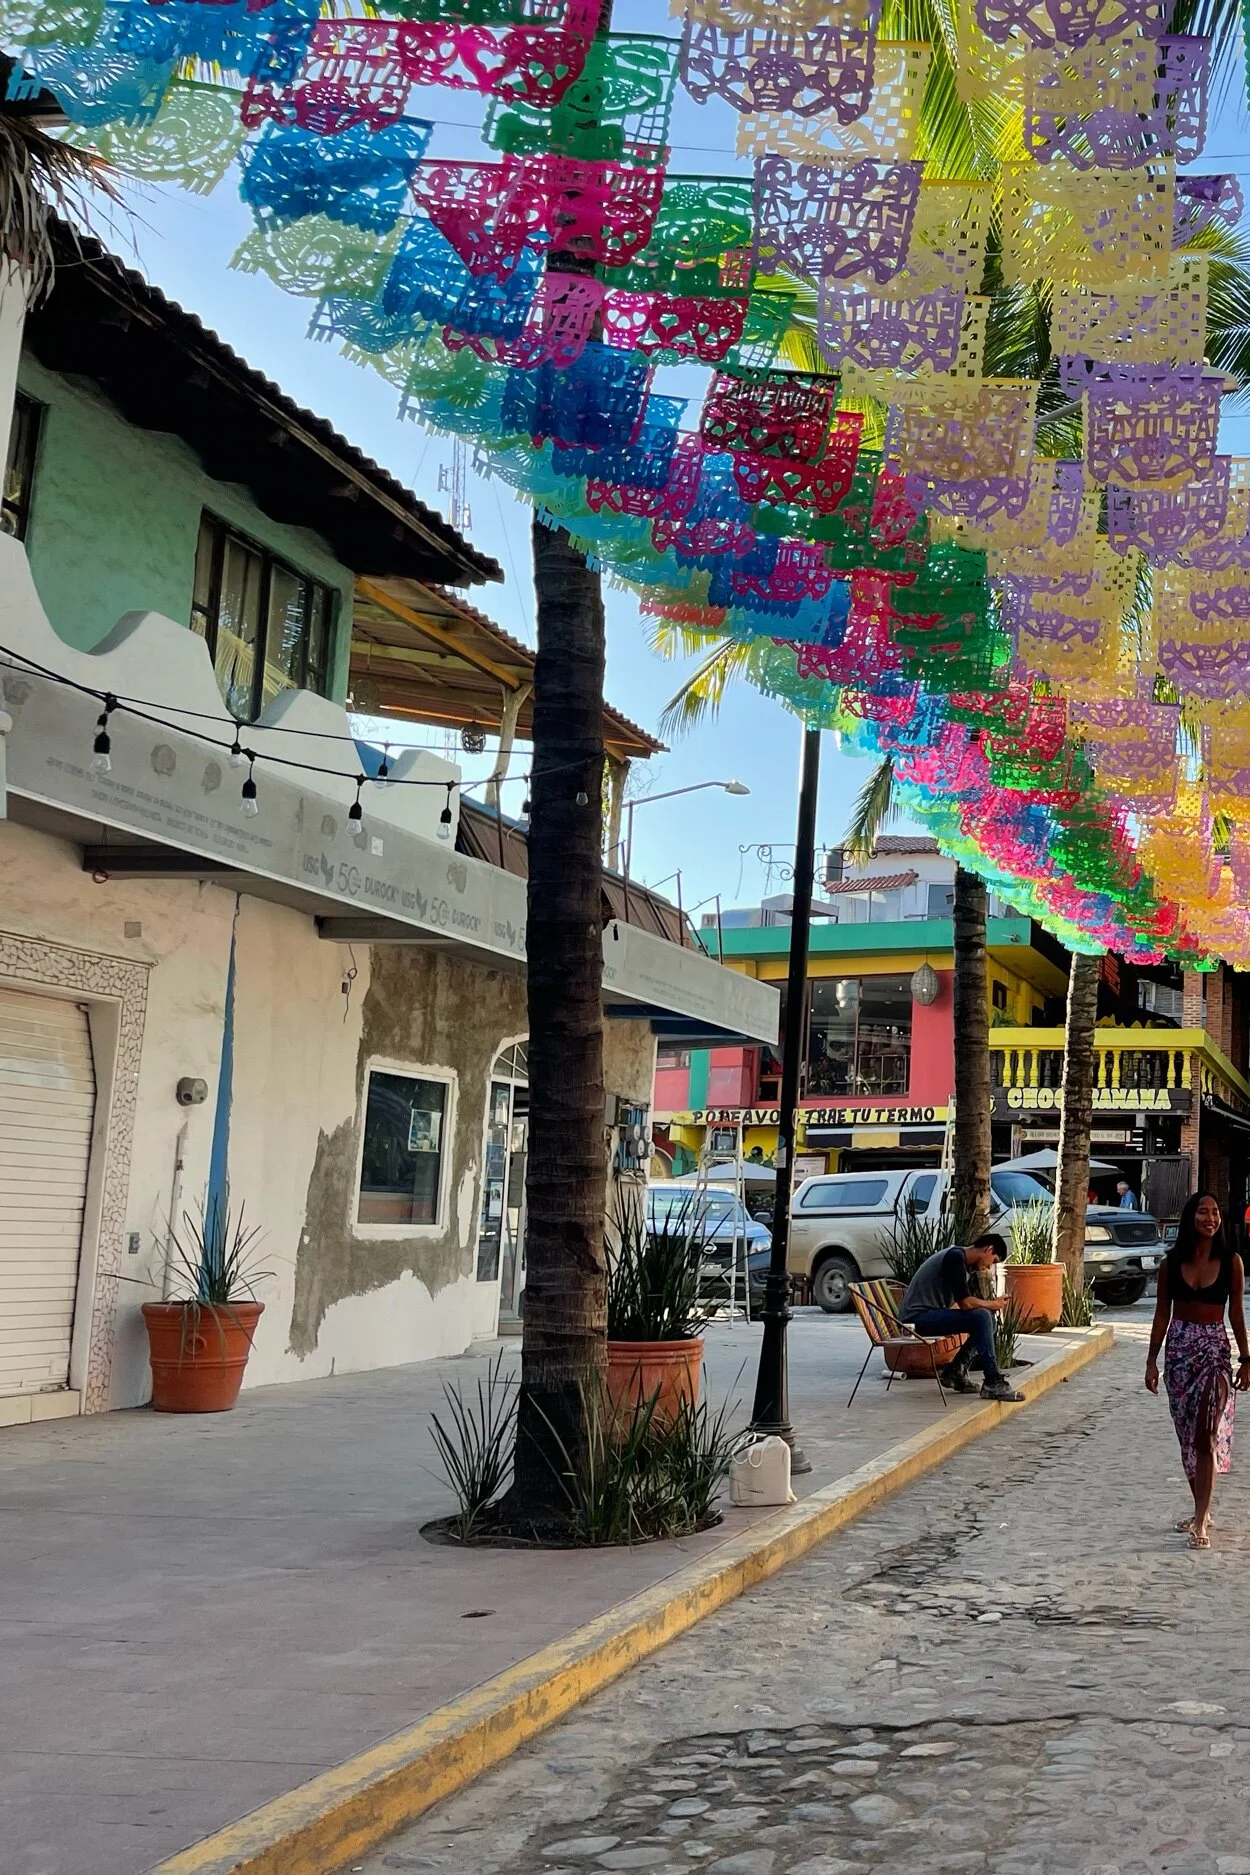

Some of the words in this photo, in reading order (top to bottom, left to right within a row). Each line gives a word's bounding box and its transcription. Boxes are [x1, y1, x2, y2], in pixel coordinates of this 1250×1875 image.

[805, 1108, 846, 1124] TRAE
[850, 1108, 873, 1123] TU
[874, 1106, 936, 1123] TERMO
